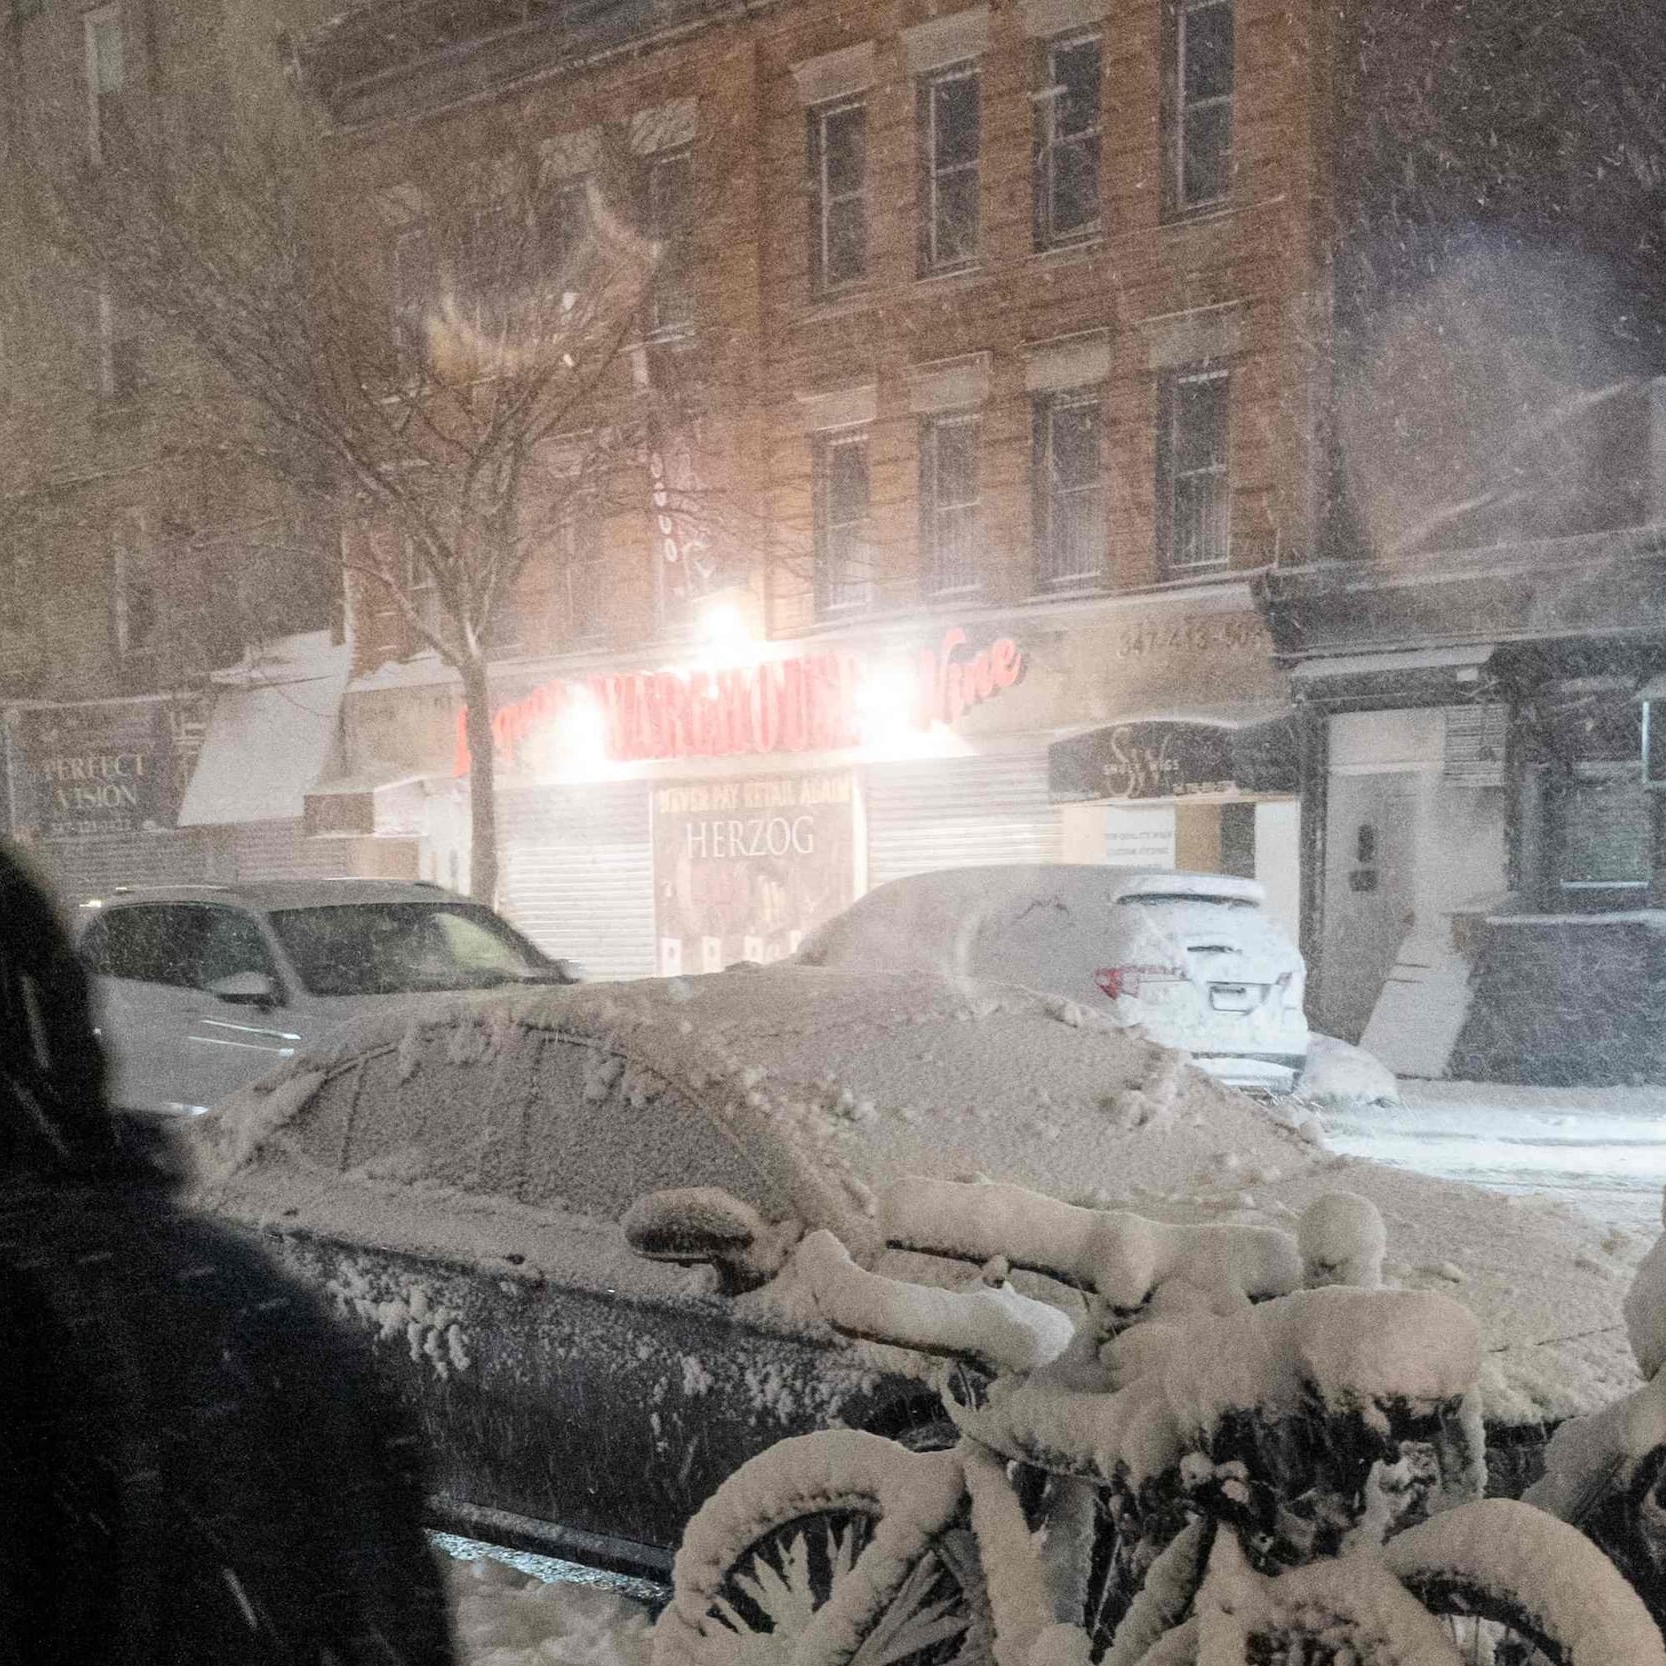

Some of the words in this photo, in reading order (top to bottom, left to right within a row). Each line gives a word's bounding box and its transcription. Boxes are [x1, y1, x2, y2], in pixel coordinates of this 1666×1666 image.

[42, 752, 144, 781] PERFECT
[54, 784, 138, 811] VISION
[686, 815, 815, 859] HERZOG
